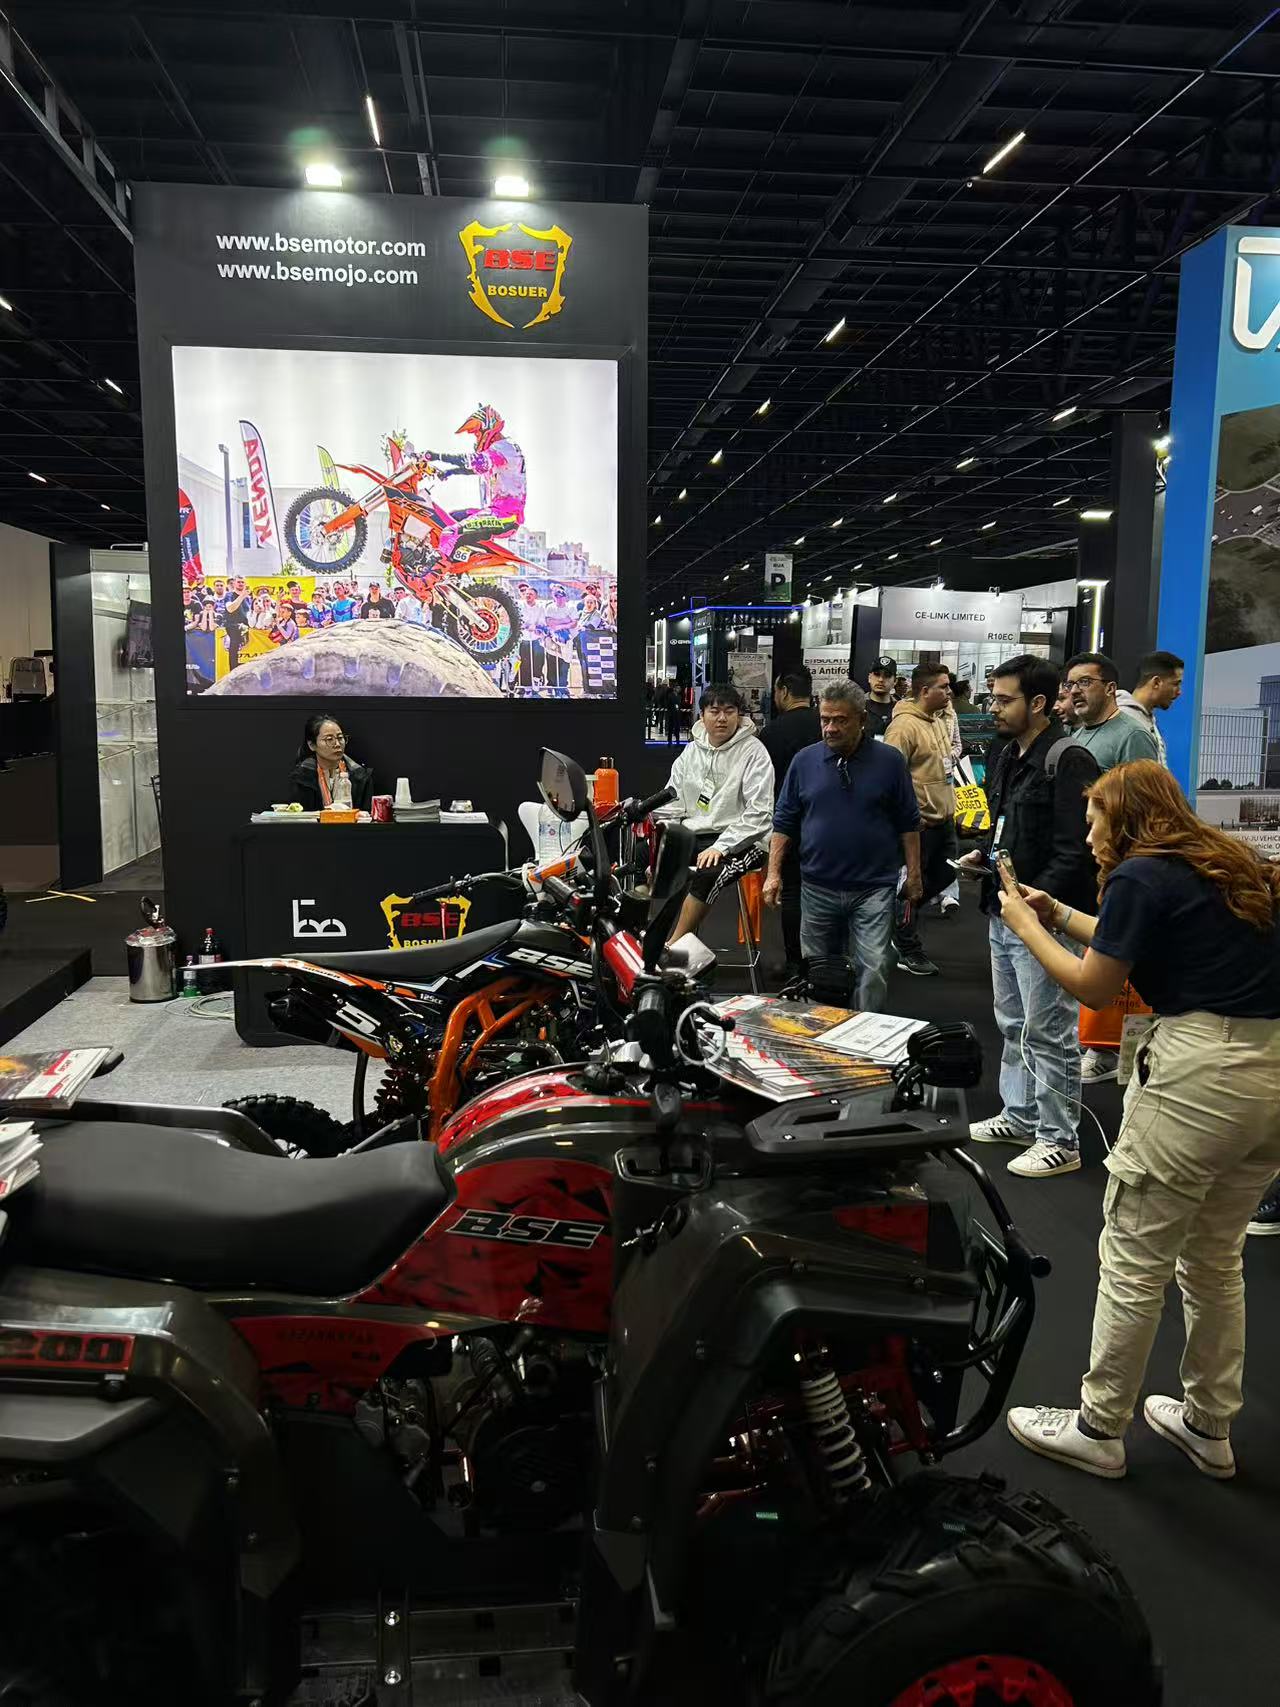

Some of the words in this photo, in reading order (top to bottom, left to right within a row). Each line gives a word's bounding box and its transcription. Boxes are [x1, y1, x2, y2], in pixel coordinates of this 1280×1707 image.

[216, 232, 426, 257] www.bsemotor.com
[484, 248, 556, 271] BSE
[217, 261, 418, 286] www.bsemojo.com
[487, 285, 548, 298] BOSUER
[455, 550, 467, 560] 86
[771, 573, 786, 592] P
[915, 611, 949, 620] CE-LINK
[952, 613, 985, 622] LIMITED
[987, 632, 1014, 641] R10EC
[401, 912, 459, 927] BSE
[506, 947, 593, 979] BSE
[445, 1208, 605, 1250] BSE
